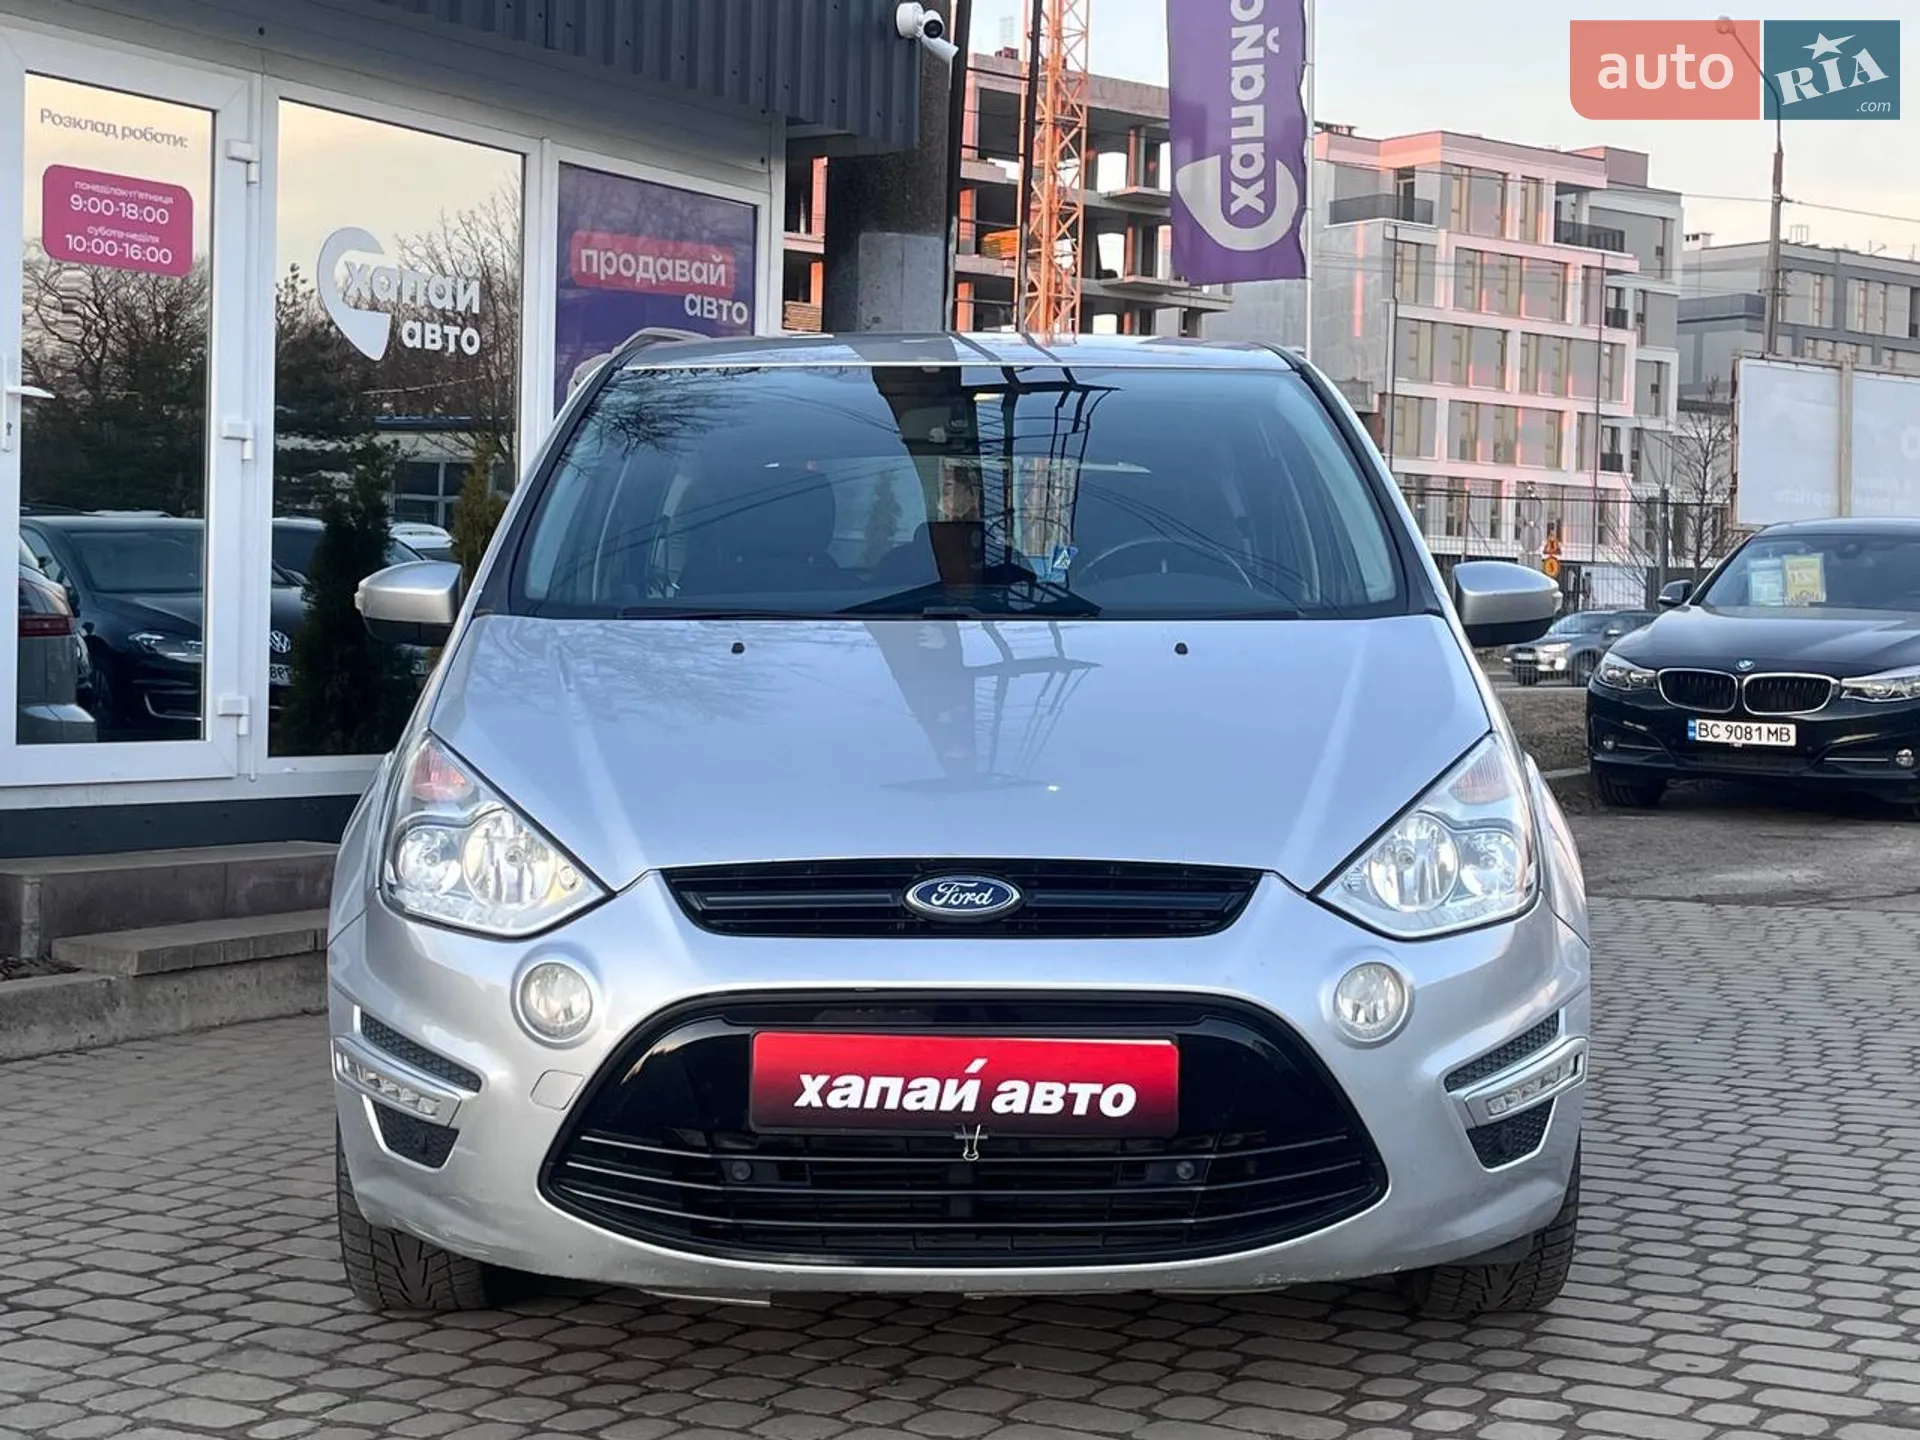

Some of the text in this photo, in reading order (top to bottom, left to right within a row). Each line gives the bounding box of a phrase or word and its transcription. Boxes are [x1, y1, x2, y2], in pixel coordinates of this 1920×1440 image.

[40, 108, 189, 148] Розклад роботи:
[70, 193, 169, 225] 9:00-18:00
[65, 234, 172, 264] 10:00-16:00
[580, 246, 727, 288] продавай
[342, 262, 481, 314] хапай
[684, 292, 749, 325] авто
[401, 320, 482, 356] авто
[1725, 724, 1763, 742] 9081
[930, 881, 994, 906] Ford
[990, 1081, 1137, 1118] авто
